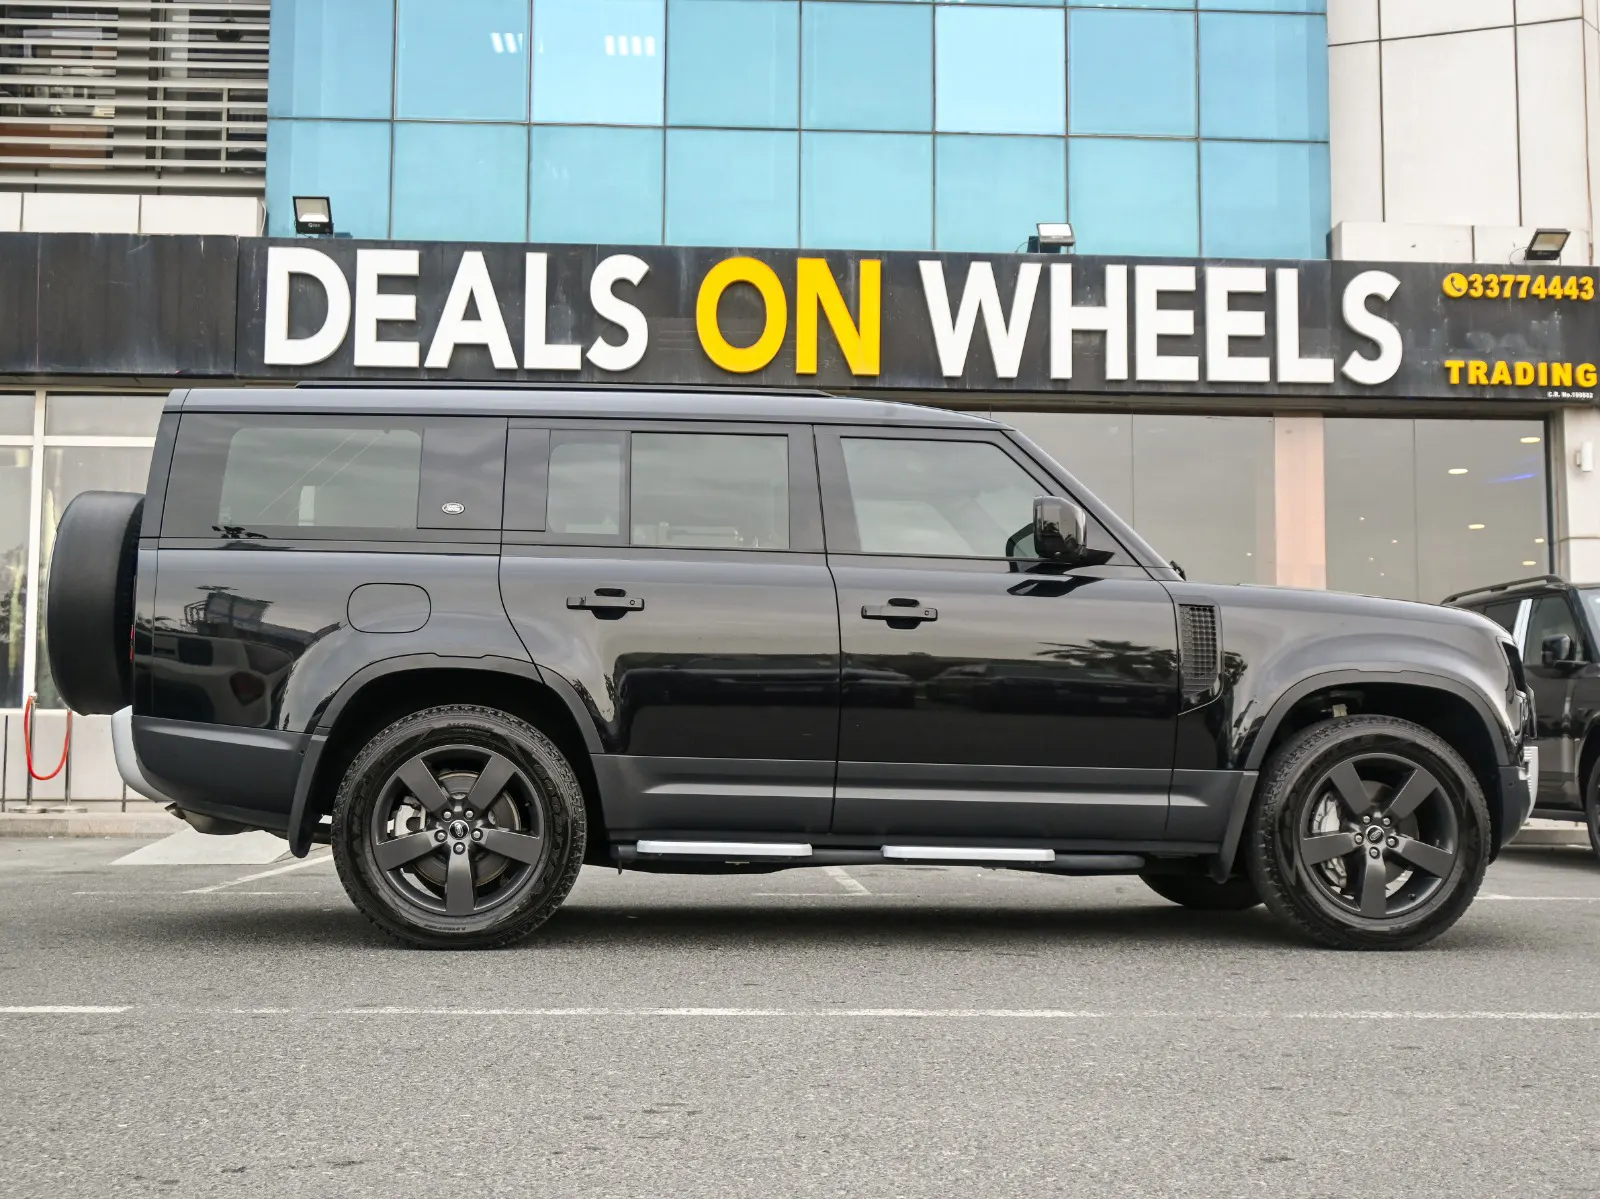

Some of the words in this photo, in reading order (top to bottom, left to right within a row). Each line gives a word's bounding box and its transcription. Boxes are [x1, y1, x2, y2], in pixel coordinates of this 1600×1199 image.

[1469, 273, 1595, 300] 33774443
[263, 246, 650, 371] DEALS
[695, 256, 882, 377] ON
[918, 259, 1403, 386] WHEELS
[1444, 359, 1598, 388] TRADING
